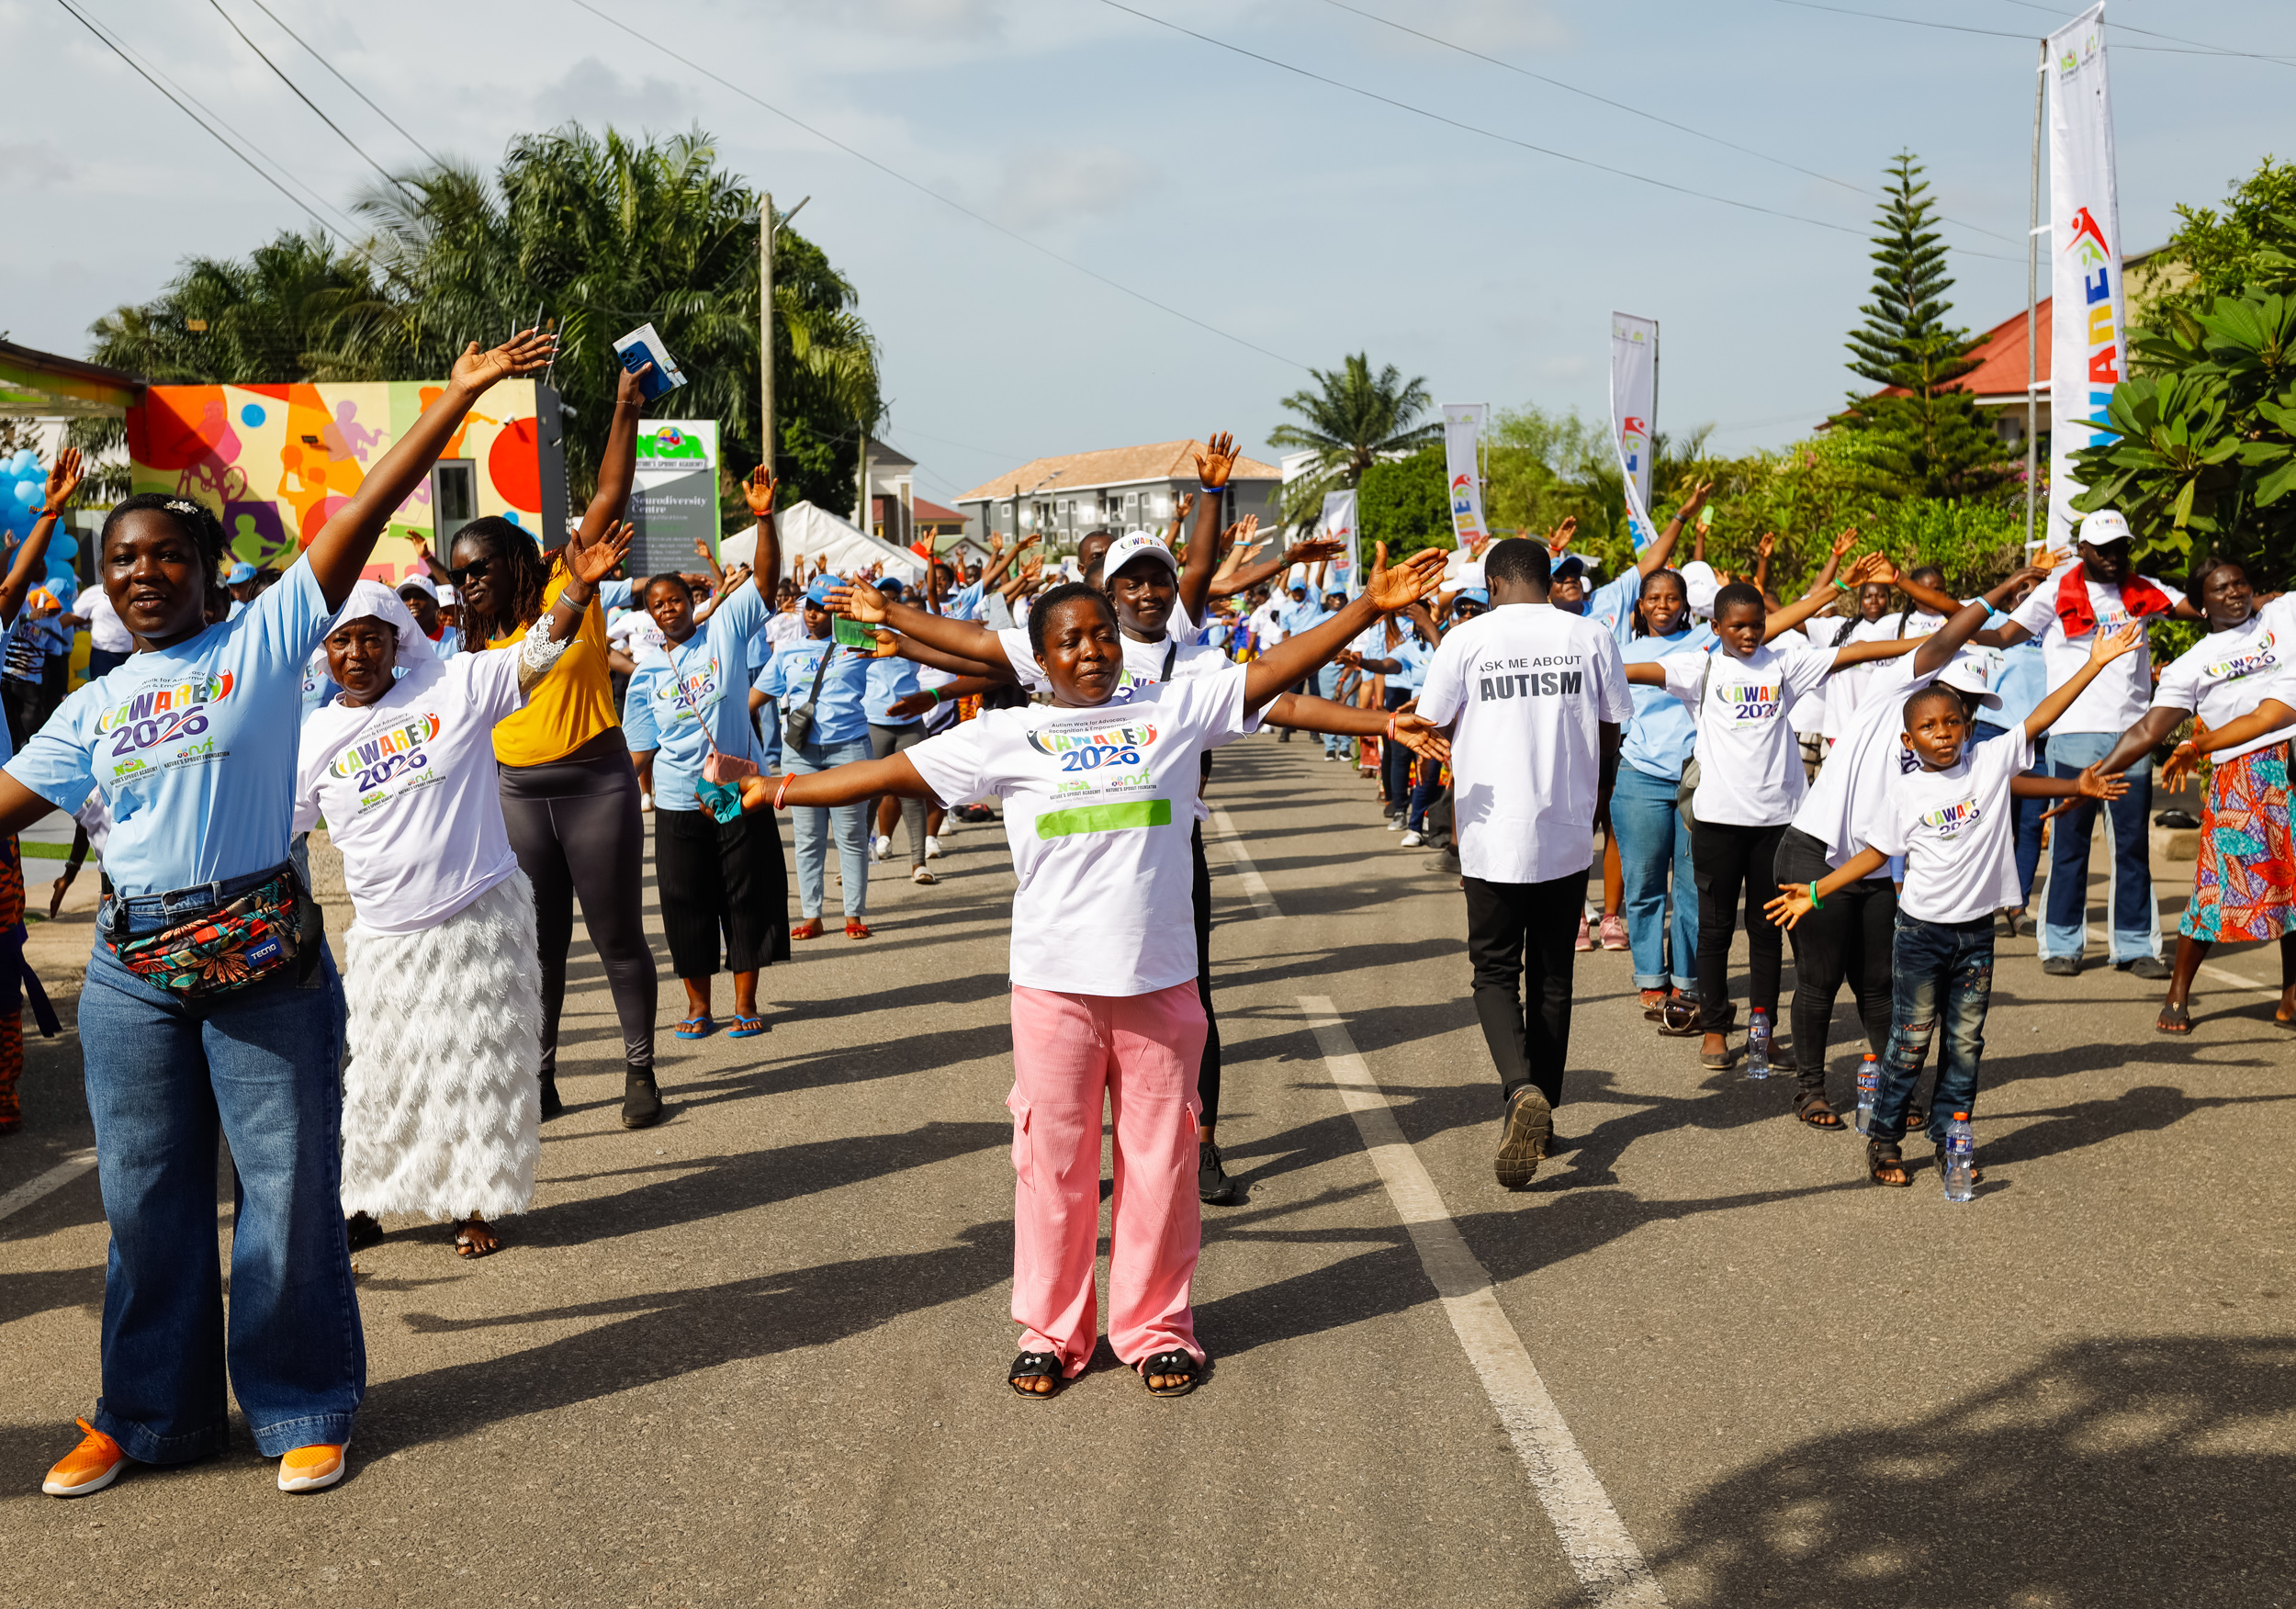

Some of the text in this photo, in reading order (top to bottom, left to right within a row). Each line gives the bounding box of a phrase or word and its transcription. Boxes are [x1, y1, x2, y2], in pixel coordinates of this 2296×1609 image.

[2084, 266, 2119, 448] WARE
[632, 495, 707, 507] Neurodiversity
[632, 505, 667, 513] Centre
[2098, 610, 2128, 624] WAR
[802, 659, 835, 672] 206
[1508, 658, 1528, 669] ME
[1532, 655, 1582, 667] ABOUT
[1480, 671, 1582, 702] AUTISM
[110, 683, 208, 730] AWARE
[109, 705, 209, 758] 2026
[1054, 727, 1138, 752] AWARE
[346, 723, 422, 773] AWARE
[1060, 745, 1141, 772] 2026
[184, 756, 202, 765] SPROUT
[354, 747, 428, 793] 2026
[123, 771, 139, 782] SPROUT
[139, 765, 159, 778] ACADEMY
[251, 943, 277, 960] TECNO
